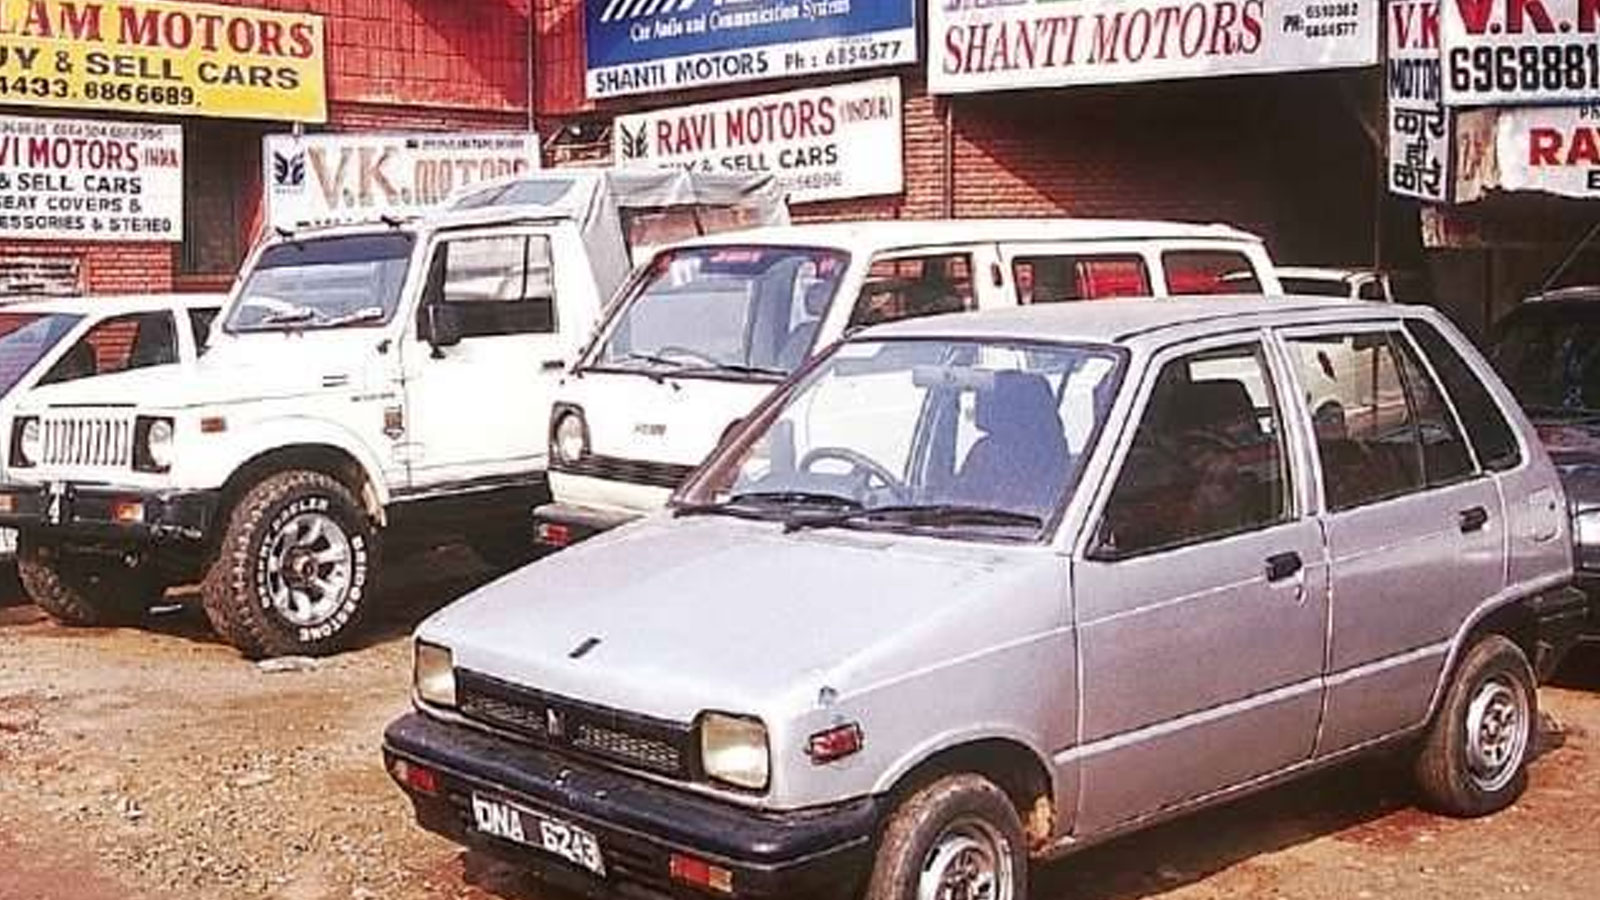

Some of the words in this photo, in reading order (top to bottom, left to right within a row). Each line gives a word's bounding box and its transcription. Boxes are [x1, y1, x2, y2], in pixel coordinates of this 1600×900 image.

[117, 5, 314, 59] MOTORS
[653, 17, 683, 39] Audio
[942, 14, 1083, 75] SHANTI
[1086, 0, 1265, 65] MOTORS
[56, 51, 72, 73] &
[86, 53, 183, 81] SELL
[199, 61, 300, 89] CARS
[596, 68, 666, 93] SHANTI
[676, 51, 769, 84] MOTORS
[1449, 43, 1600, 92] 6968881
[657, 111, 717, 156] RAVI
[726, 96, 836, 148] MOTORS
[29, 137, 139, 172] MOTORS
[779, 144, 838, 169] CARS
[1529, 126, 1600, 166] RA
[17, 173, 74, 192] SELL
[84, 175, 142, 195] CARS
[48, 197, 122, 213] COVERS
[109, 217, 172, 233] STEREO
